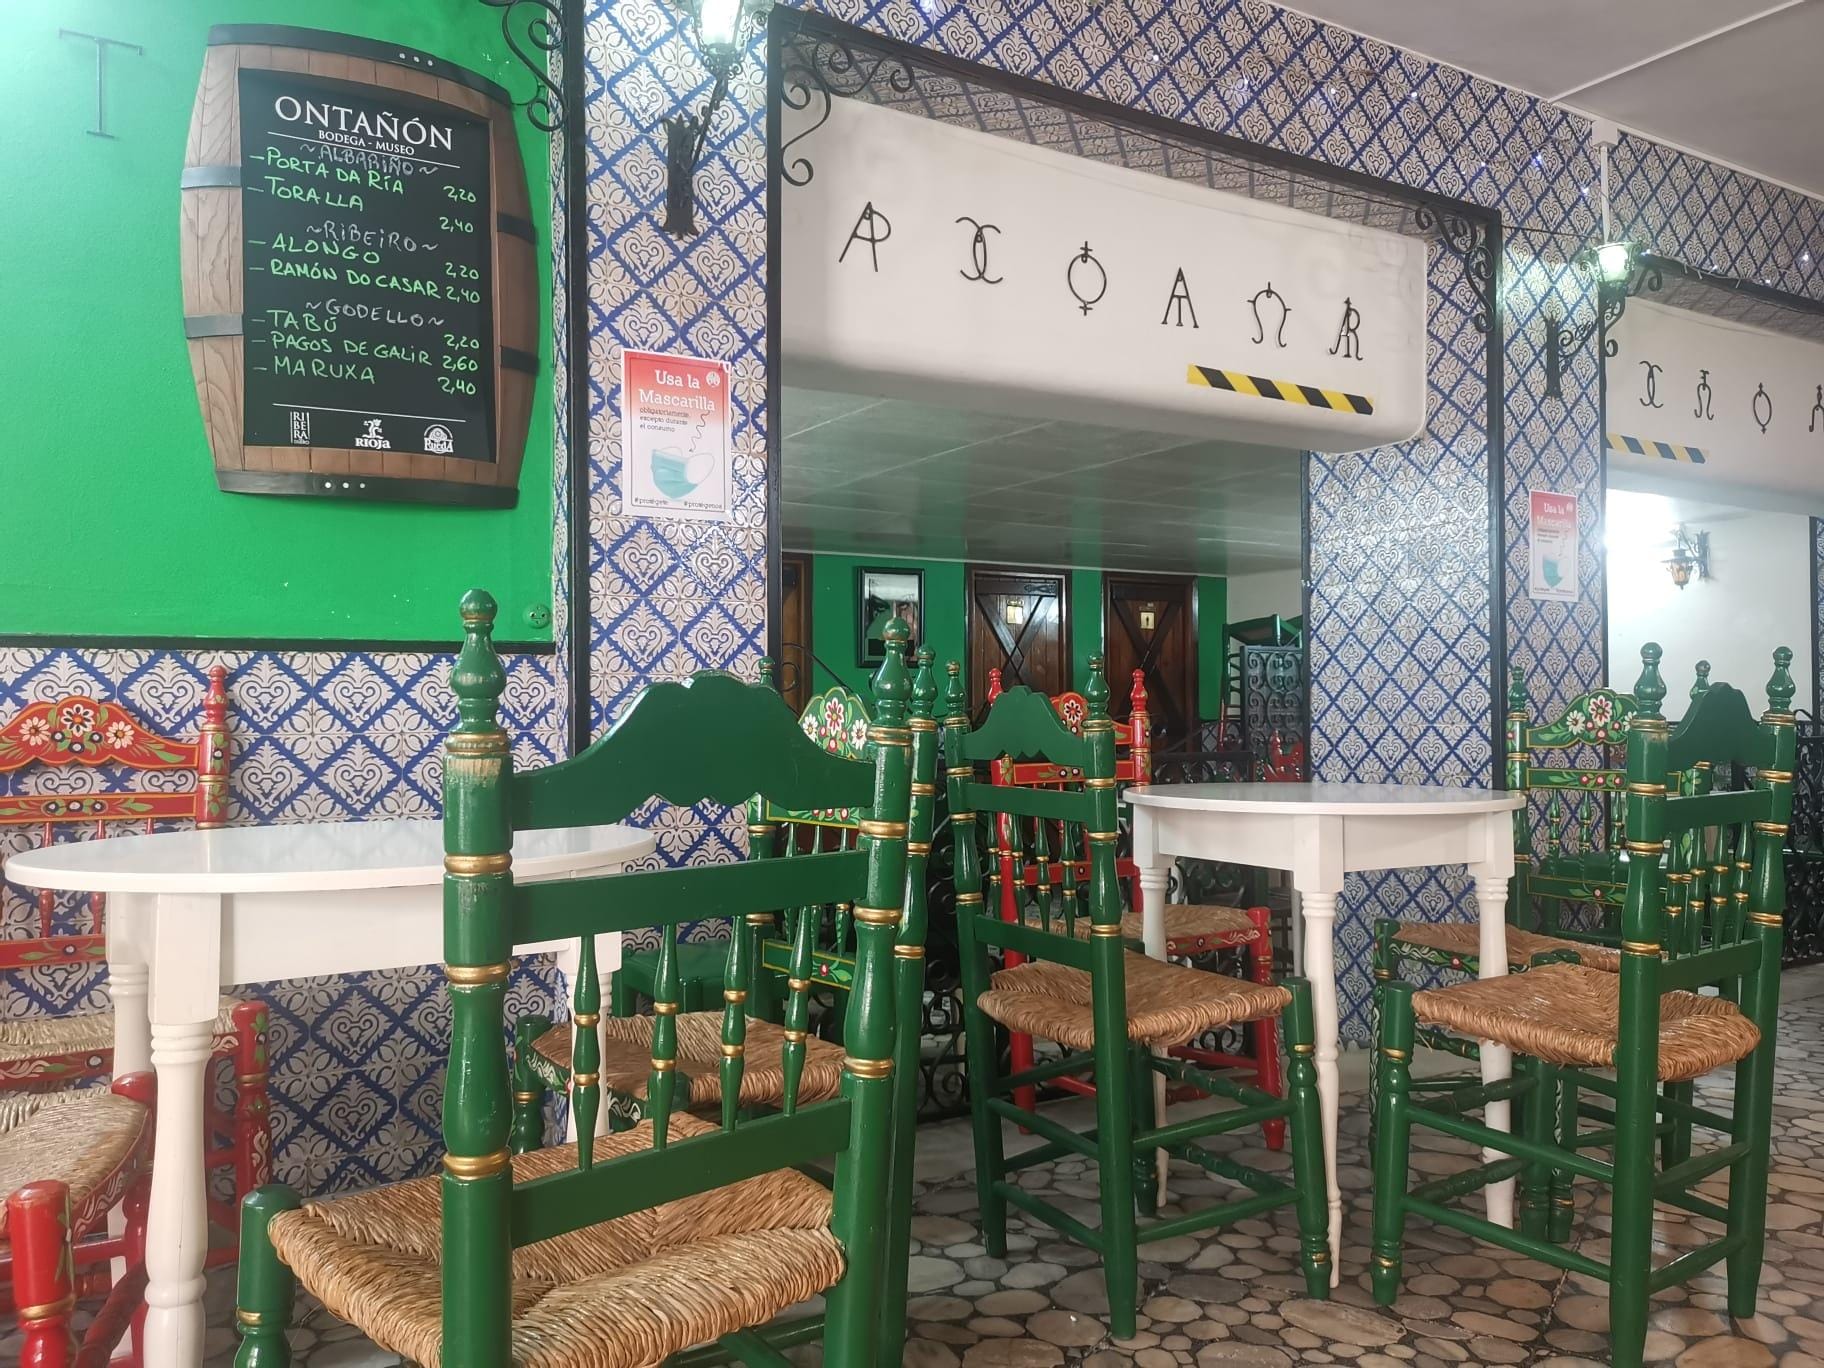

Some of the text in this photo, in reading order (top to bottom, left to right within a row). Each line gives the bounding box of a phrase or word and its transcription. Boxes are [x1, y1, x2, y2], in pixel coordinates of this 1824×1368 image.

[274, 95, 453, 151] ONTAÑÓN
[318, 130, 366, 147] BODEGA
[375, 141, 415, 155] MUSEO
[375, 274, 441, 300] CASAR
[343, 339, 369, 356] DE
[654, 369, 700, 390] Usa la
[638, 388, 716, 412] Mascarilla
